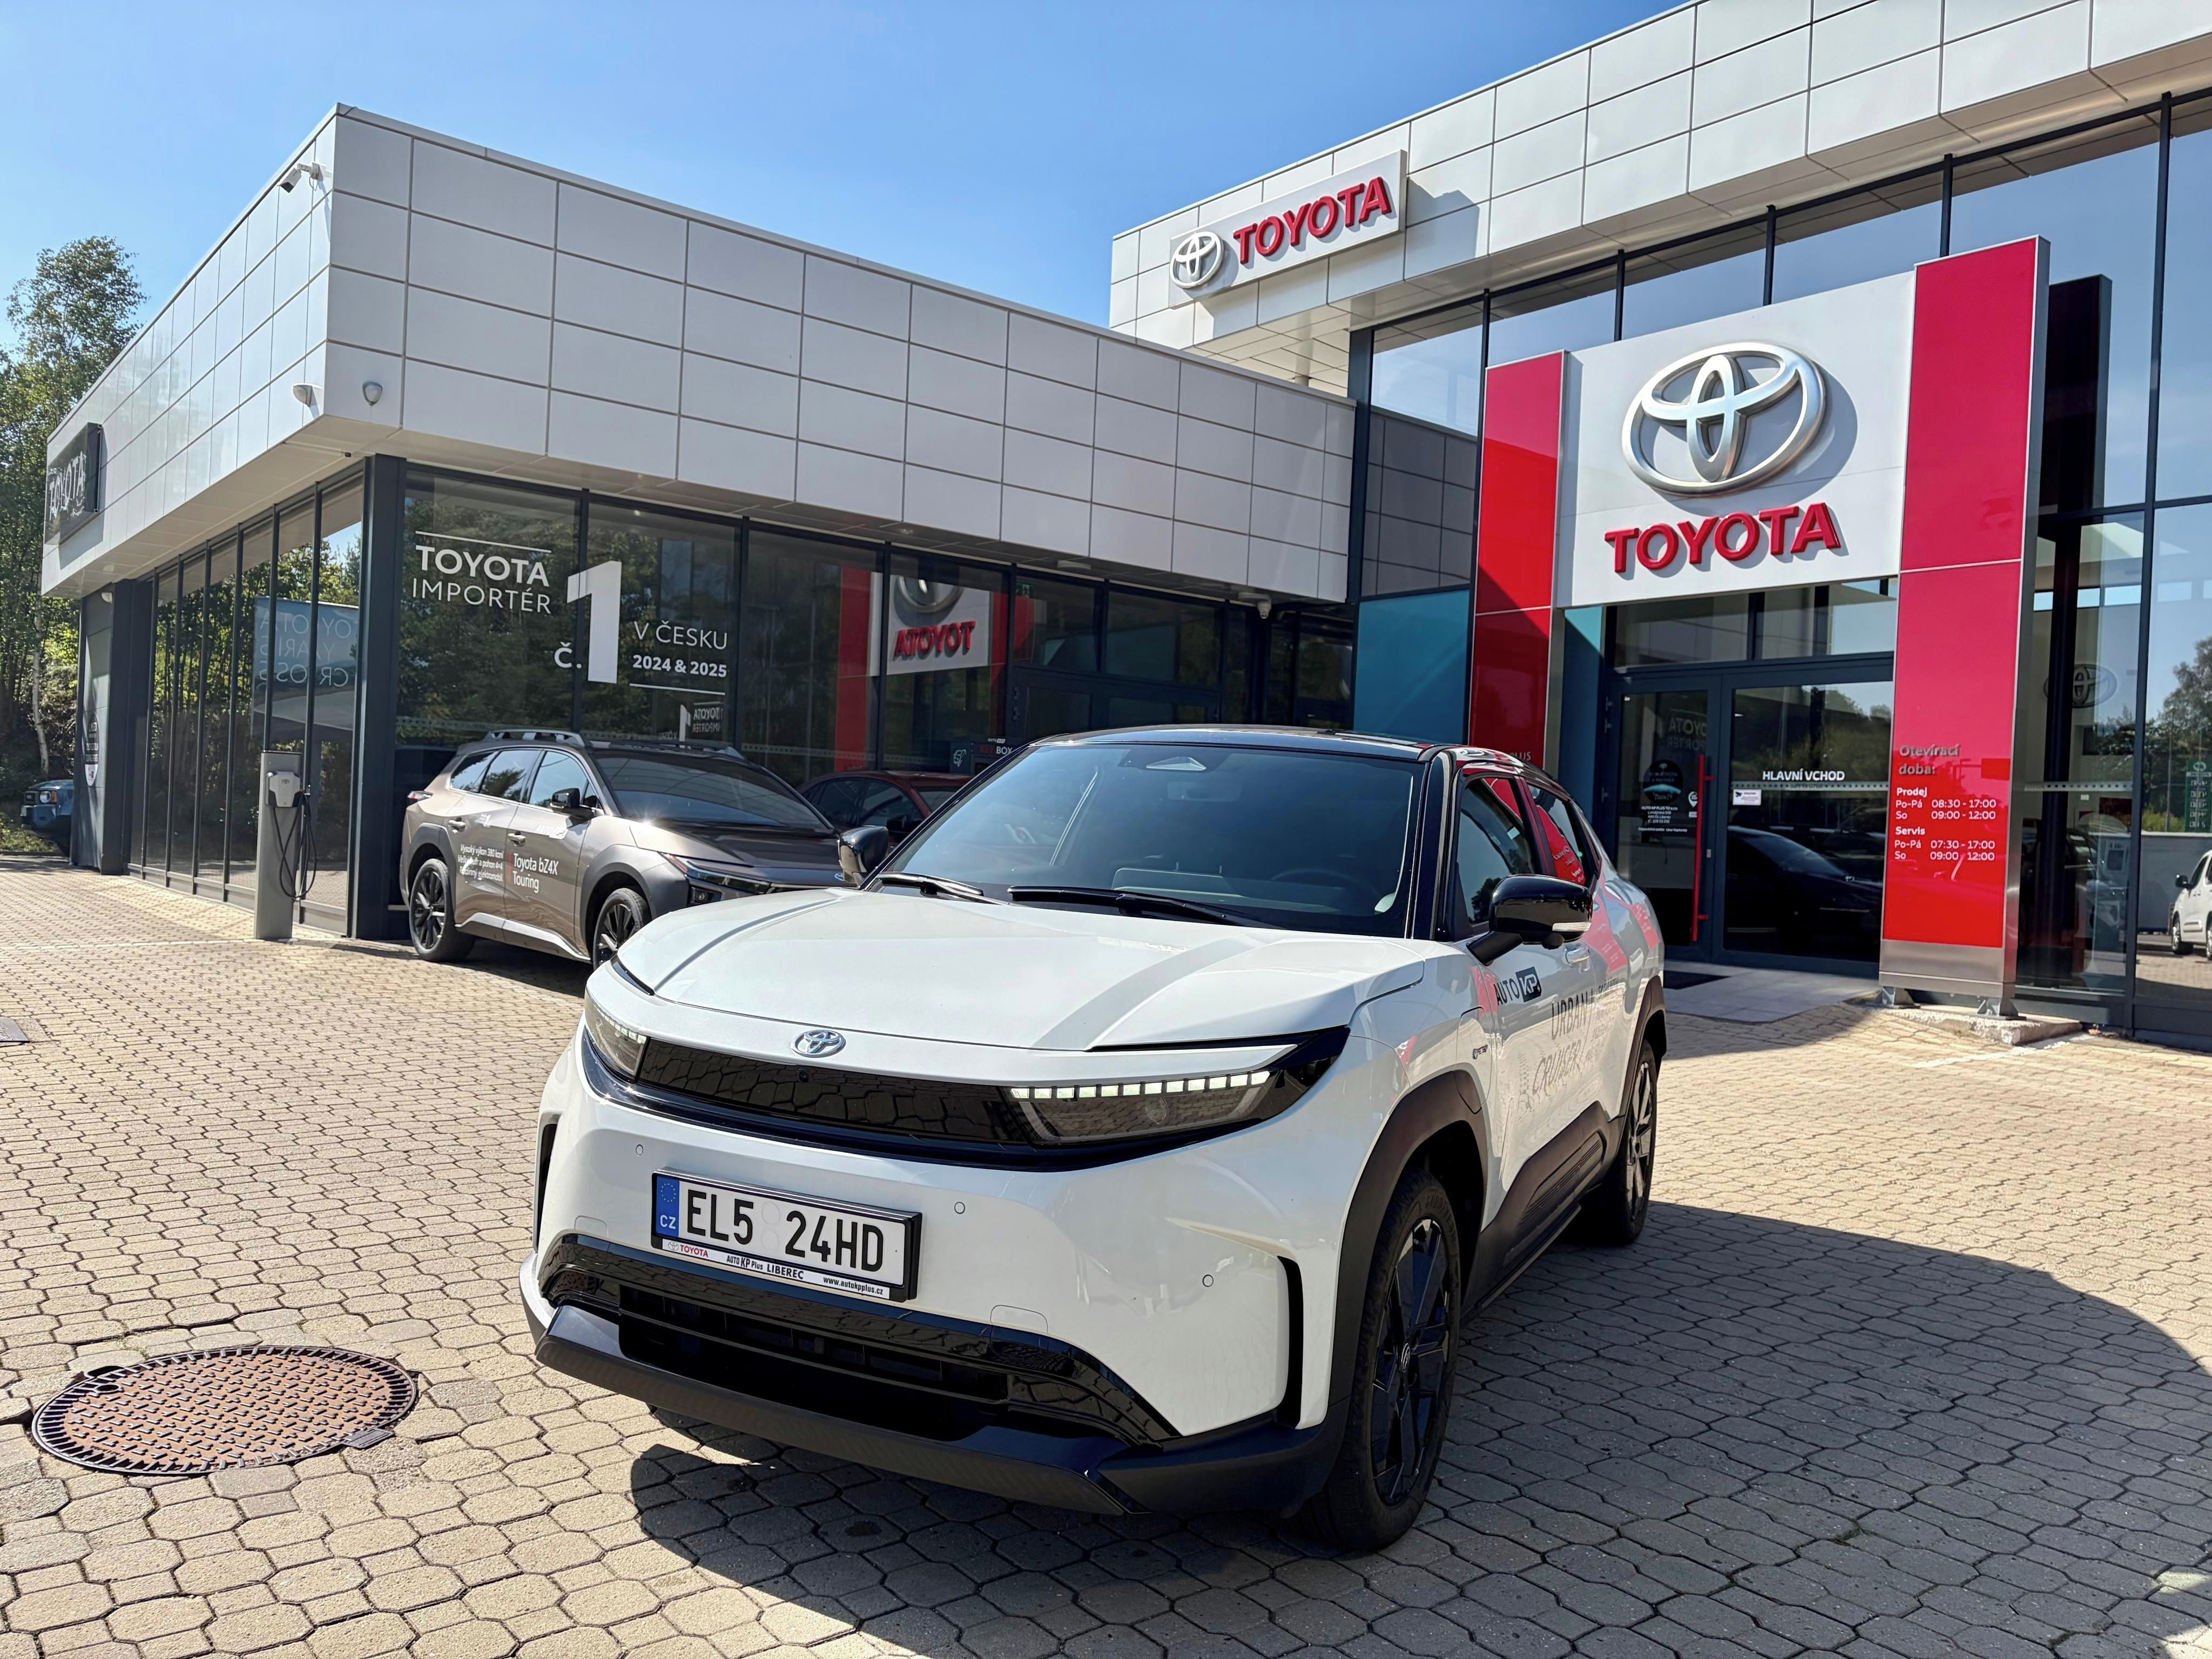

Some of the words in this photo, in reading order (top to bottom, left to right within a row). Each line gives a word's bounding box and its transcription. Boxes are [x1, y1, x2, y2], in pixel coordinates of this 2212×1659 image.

[1233, 177, 1392, 264] TOYOTA
[49, 451, 85, 521] TOYOTA
[1604, 502, 1841, 574] TOYOTA
[415, 544, 550, 587] TOYOTA
[412, 577, 551, 615] IMPORTÉR
[567, 560, 622, 684] 1
[634, 621, 650, 641] V
[655, 619, 728, 650] ČESKU
[632, 655, 671, 672] 2024
[674, 659, 687, 673] &
[690, 661, 727, 678] 2025
[1899, 743, 1960, 757] Otevírací
[1762, 768, 1803, 781] HLAVNÍ
[1805, 771, 1845, 781] VCHOD
[1898, 763, 1936, 775] doba:
[1896, 786, 1927, 798] Prodej
[1896, 799, 1923, 808] Po-Pá
[1931, 799, 1960, 808] 08:30
[1969, 799, 1997, 808] 17:00
[1896, 811, 1907, 820] So
[1931, 811, 1960, 820] 09:00
[1968, 811, 1996, 820] 12:00
[1895, 826, 1926, 836] Servis
[1894, 840, 1921, 849] Po-Pá
[1930, 840, 1959, 849] 07:30
[1967, 840, 1995, 849] 17:00
[1894, 851, 1906, 860] So
[1930, 852, 1959, 860] 09:00
[1967, 852, 1995, 861] 12:00
[514, 853, 537, 873] Toyota
[538, 857, 559, 876] bZ4X
[512, 871, 539, 894] Touring
[1494, 978, 1520, 1006] AUTO
[1551, 991, 1588, 1040] URBAN
[659, 1213, 677, 1230] CZ
[687, 1189, 754, 1245] EL5
[785, 1210, 884, 1272] 24HD
[680, 1245, 709, 1258] TOYOTA
[726, 1255, 740, 1265] AUTO
[740, 1257, 751, 1268] KP
[751, 1260, 764, 1271] Plus
[766, 1263, 804, 1280] LIBEREC
[822, 1276, 884, 1296] www.autokpplus.cz
